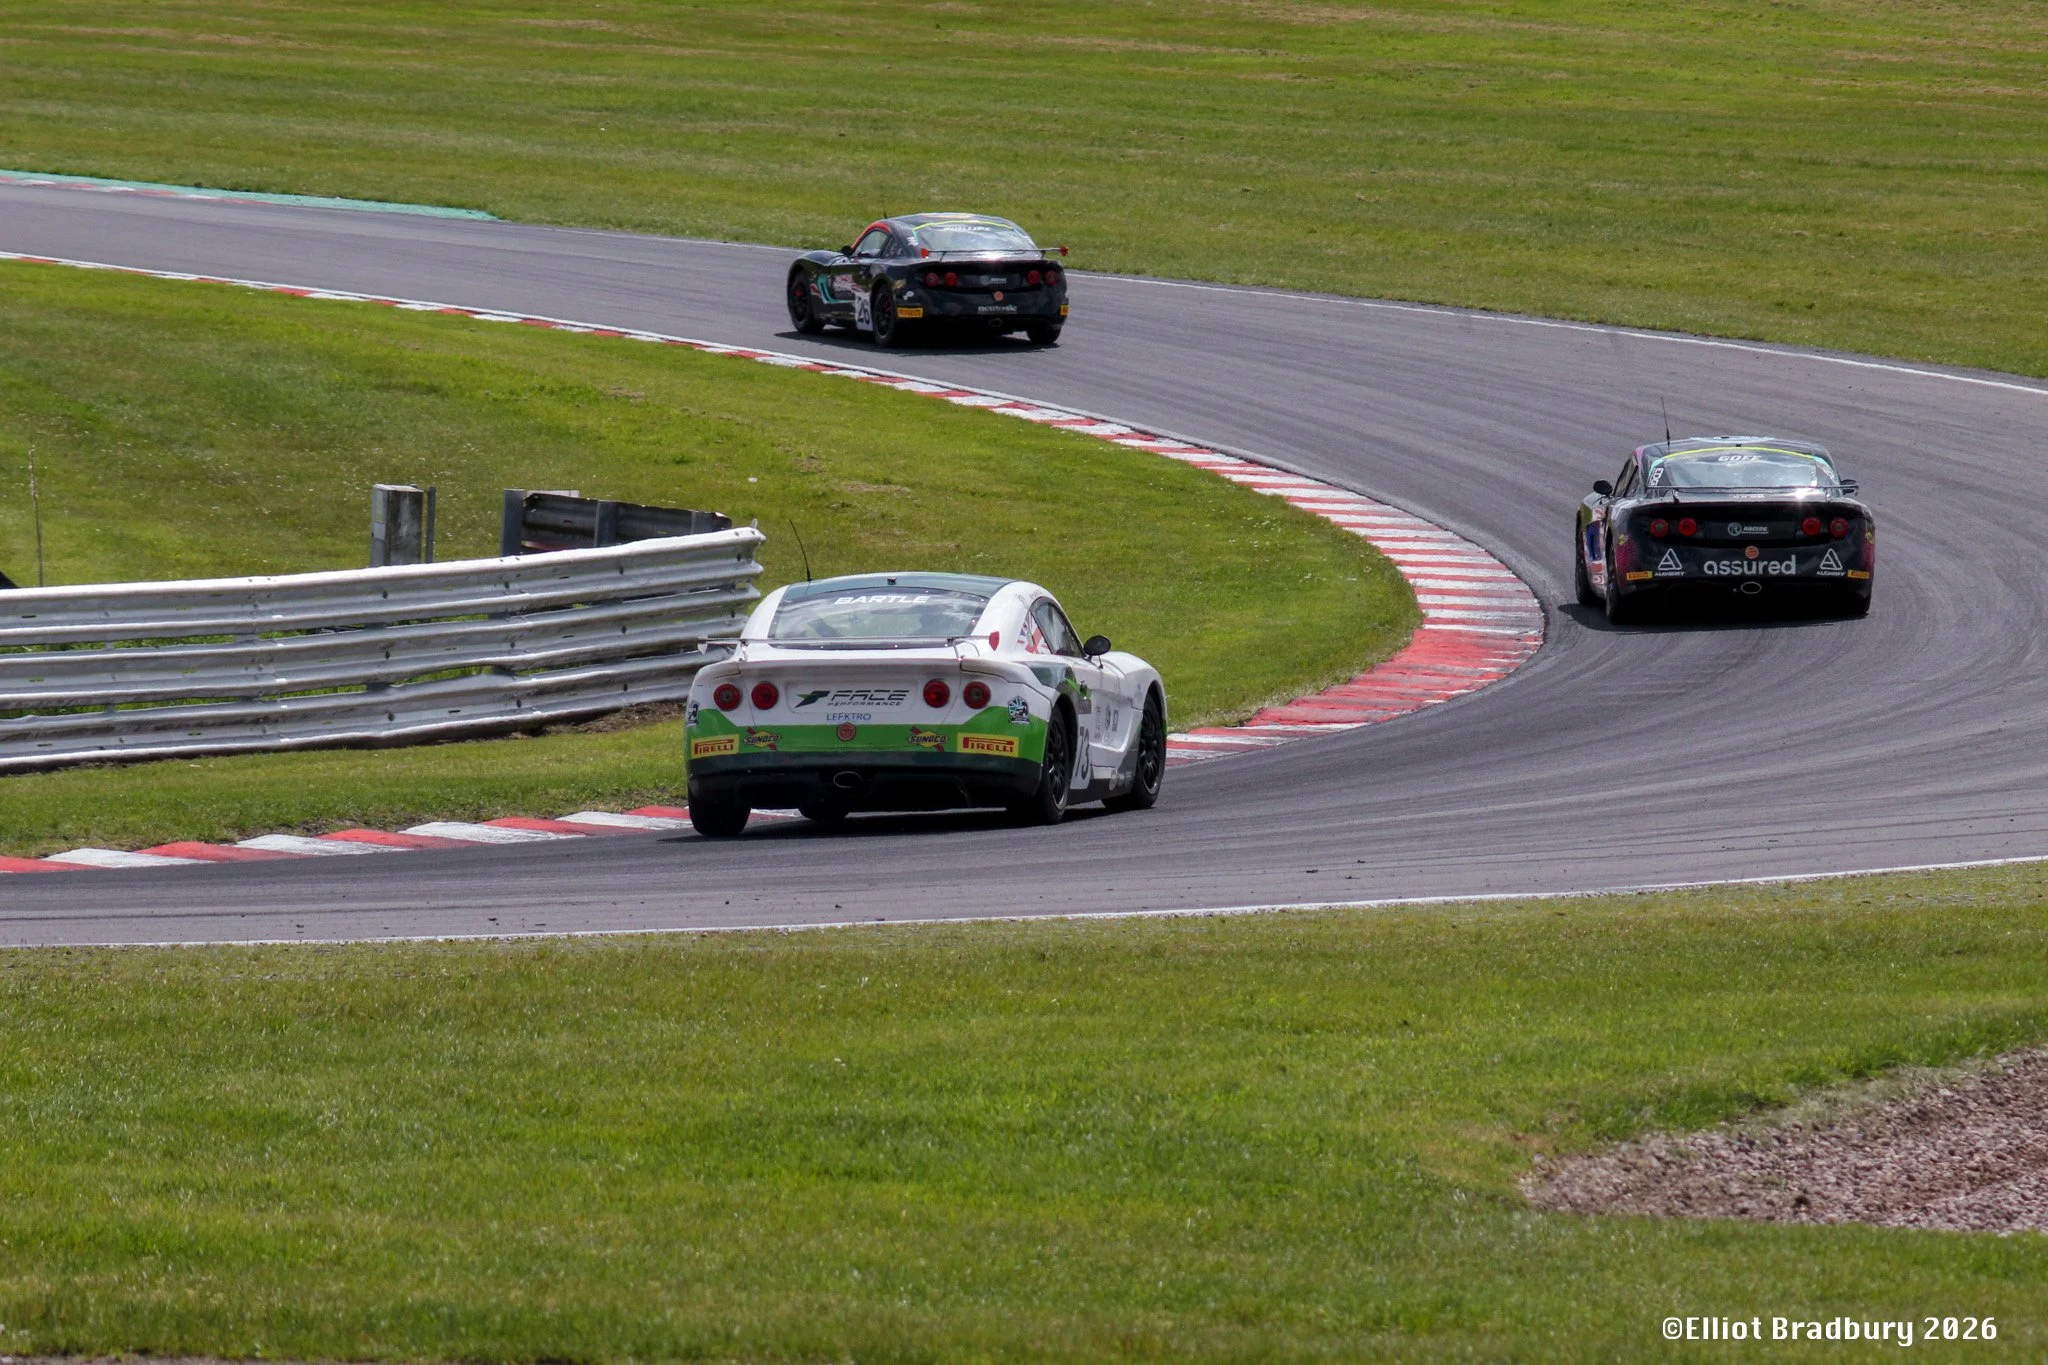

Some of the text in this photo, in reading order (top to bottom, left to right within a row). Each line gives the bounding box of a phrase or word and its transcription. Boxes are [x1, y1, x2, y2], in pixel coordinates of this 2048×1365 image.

[1703, 554, 1797, 576] assured
[833, 594, 931, 605] BARTLE
[745, 734, 781, 744] SUNOCO
[910, 734, 948, 744] SUNOCO
[962, 736, 1015, 753] PIRELLI
[694, 738, 735, 755] PIRELLI
